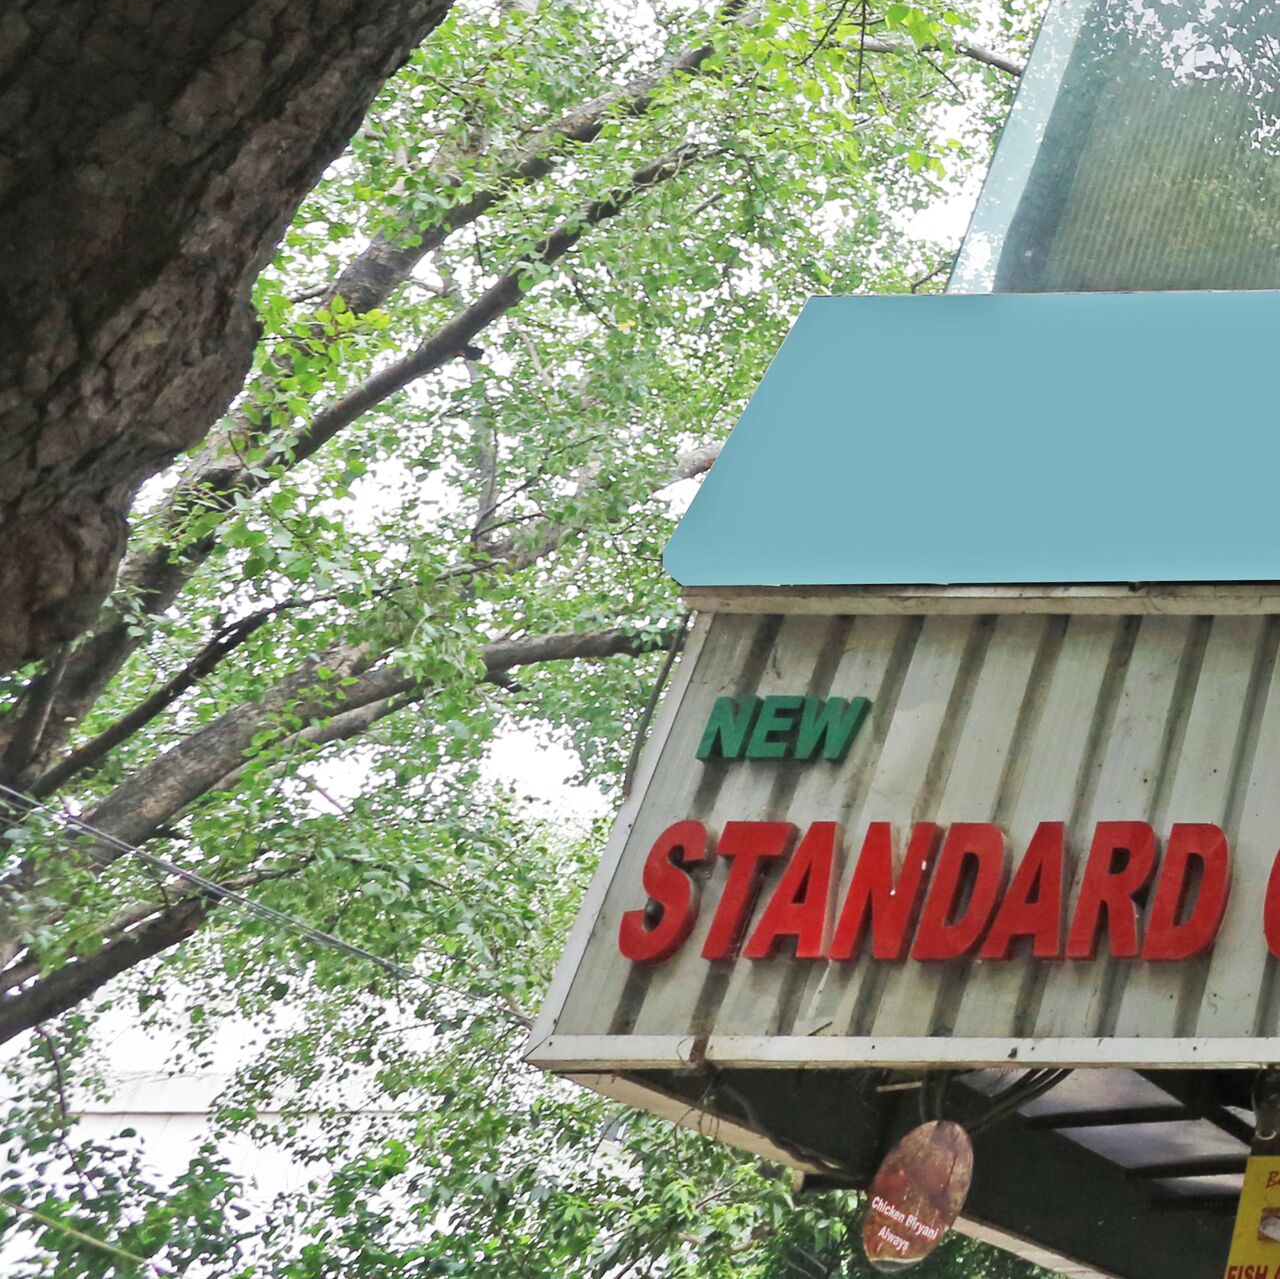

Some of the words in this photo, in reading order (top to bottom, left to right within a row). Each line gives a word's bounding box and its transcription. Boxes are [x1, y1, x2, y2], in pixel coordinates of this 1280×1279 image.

[697, 695, 872, 761] NEW
[618, 819, 1232, 963] STANDARD
[871, 1196, 905, 1223] Chicken
[905, 1214, 939, 1240] Biryani
[878, 1225, 910, 1251] Always
[1226, 1266, 1269, 1279] FISH
